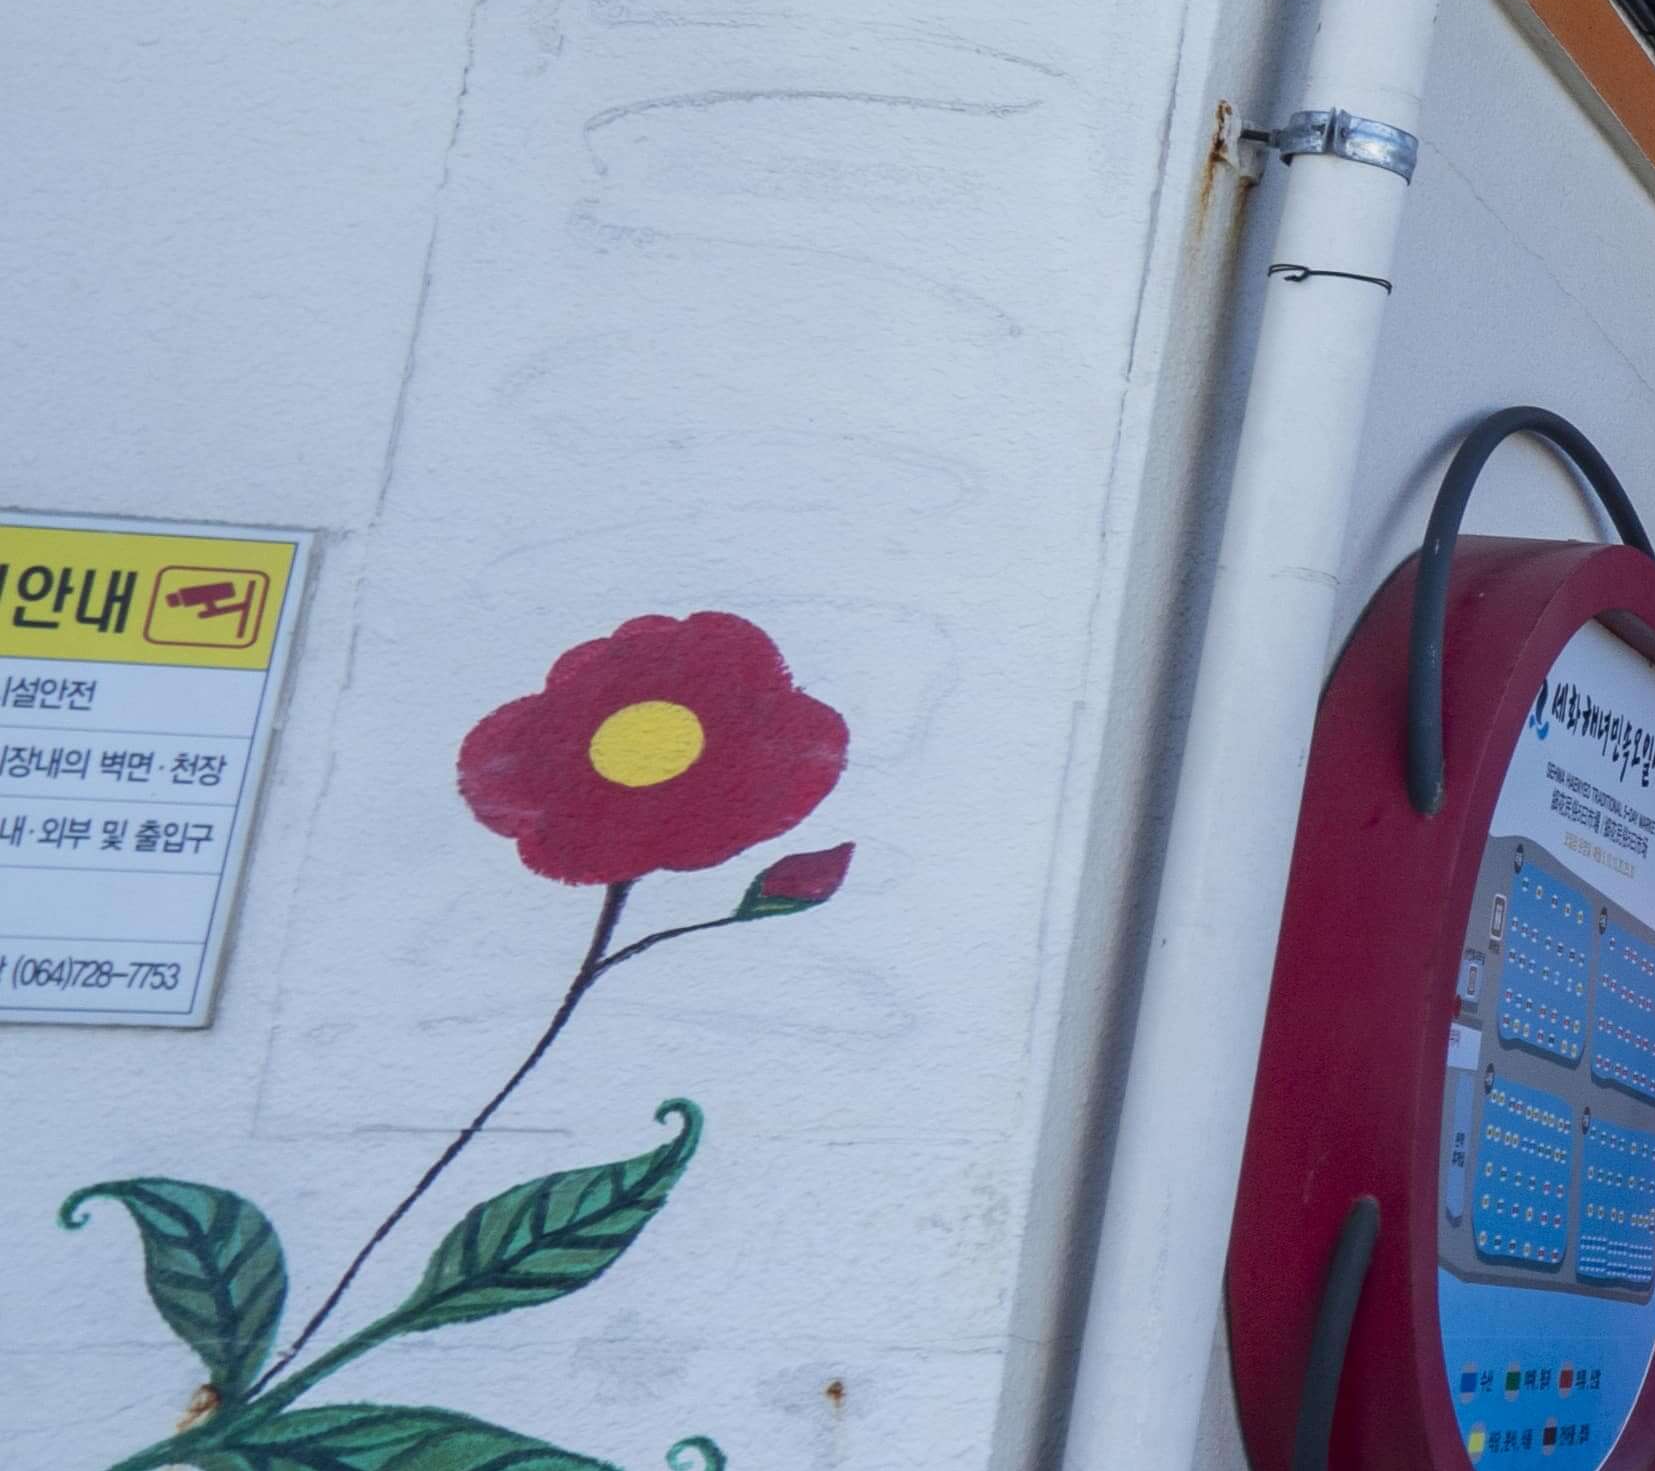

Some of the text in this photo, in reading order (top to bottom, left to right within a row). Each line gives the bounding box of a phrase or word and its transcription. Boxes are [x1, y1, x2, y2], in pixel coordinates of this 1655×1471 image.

[0, 564, 137, 634] 안내
[100, 819, 128, 851] 및
[134, 819, 214, 854] 출입구
[13, 954, 181, 990] (064)728-7753
